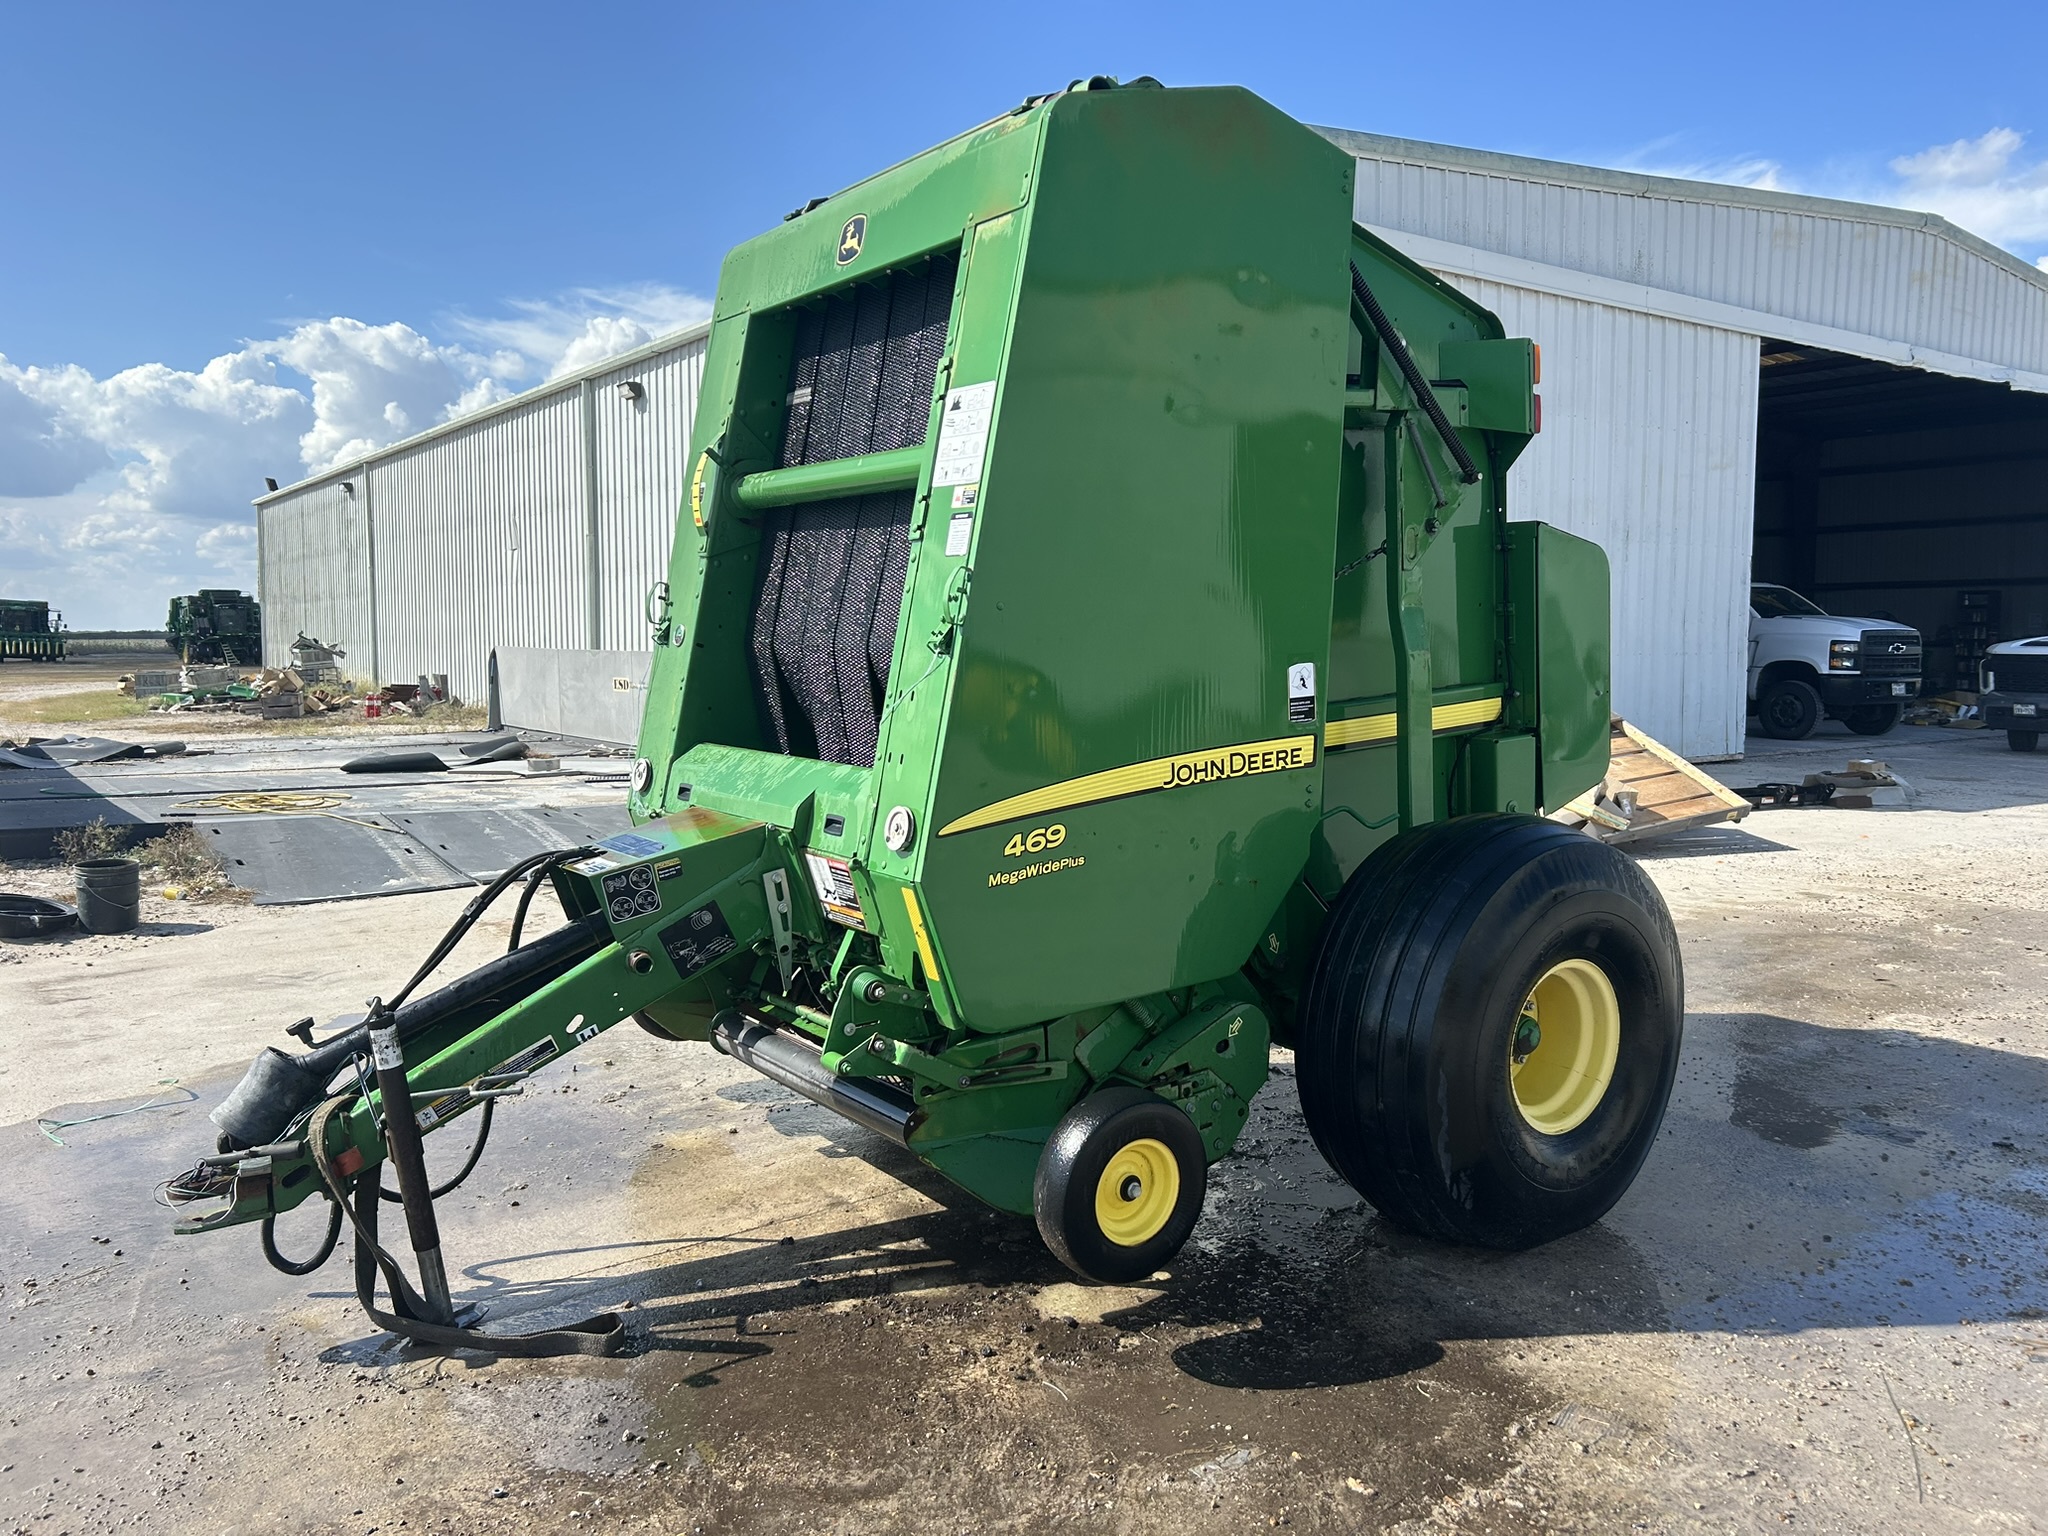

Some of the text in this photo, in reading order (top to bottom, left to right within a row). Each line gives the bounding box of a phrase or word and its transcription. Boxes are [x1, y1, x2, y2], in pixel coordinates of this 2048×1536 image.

[1163, 747, 1303, 786] JOHN DEERE
[1004, 823, 1067, 857] 469
[988, 856, 1085, 888] MegaWidePlus
